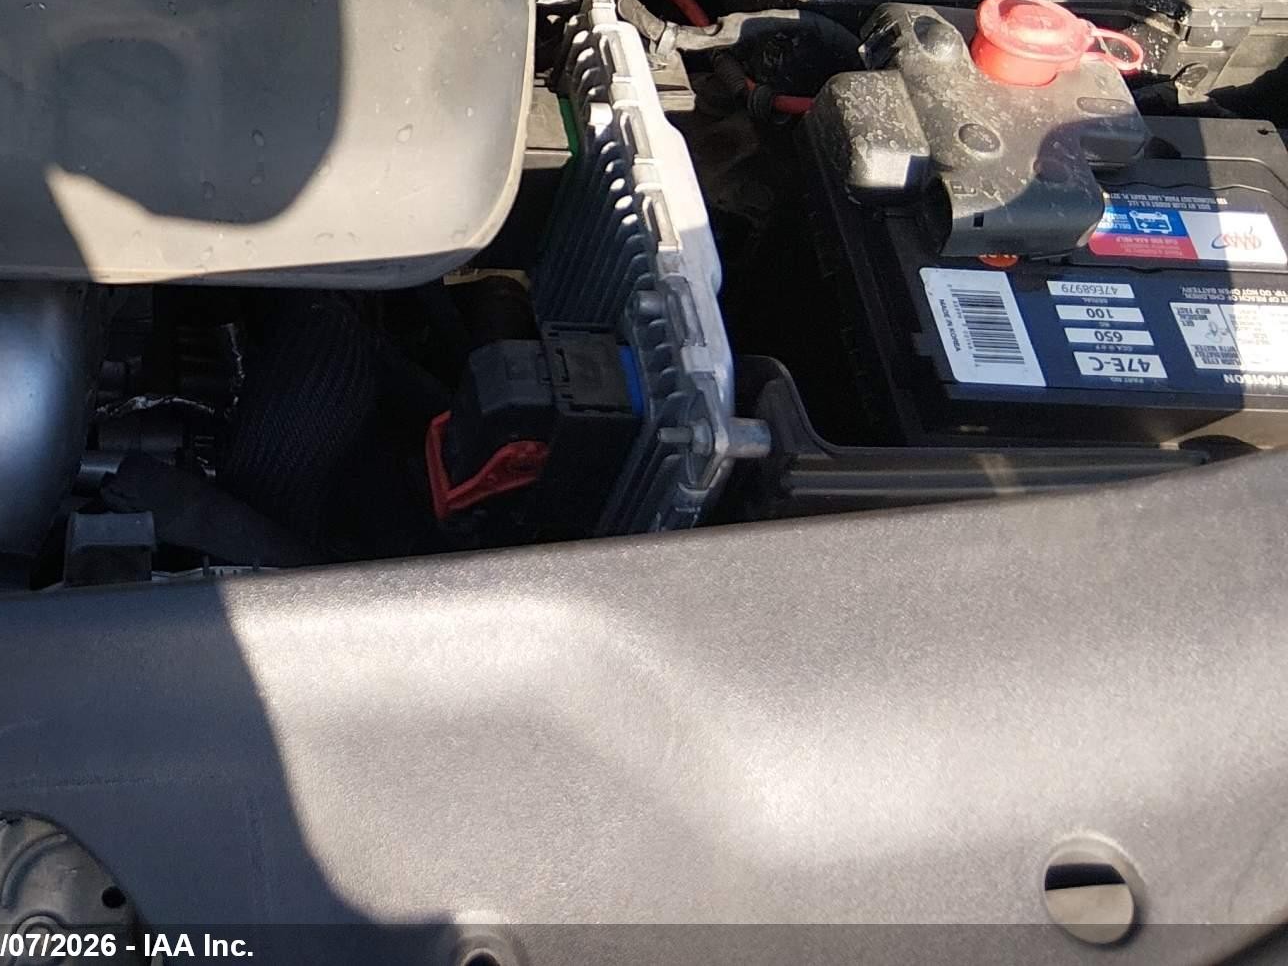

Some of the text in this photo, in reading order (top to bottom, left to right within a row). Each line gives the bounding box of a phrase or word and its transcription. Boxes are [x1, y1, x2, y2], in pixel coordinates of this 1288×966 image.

[1061, 283, 1118, 295] 47E68979
[1085, 307, 1115, 319] 100
[938, 298, 953, 318] MADE
[948, 327, 962, 352] KOREA
[1094, 330, 1123, 343] 650
[1087, 356, 1151, 373] 47E-C
